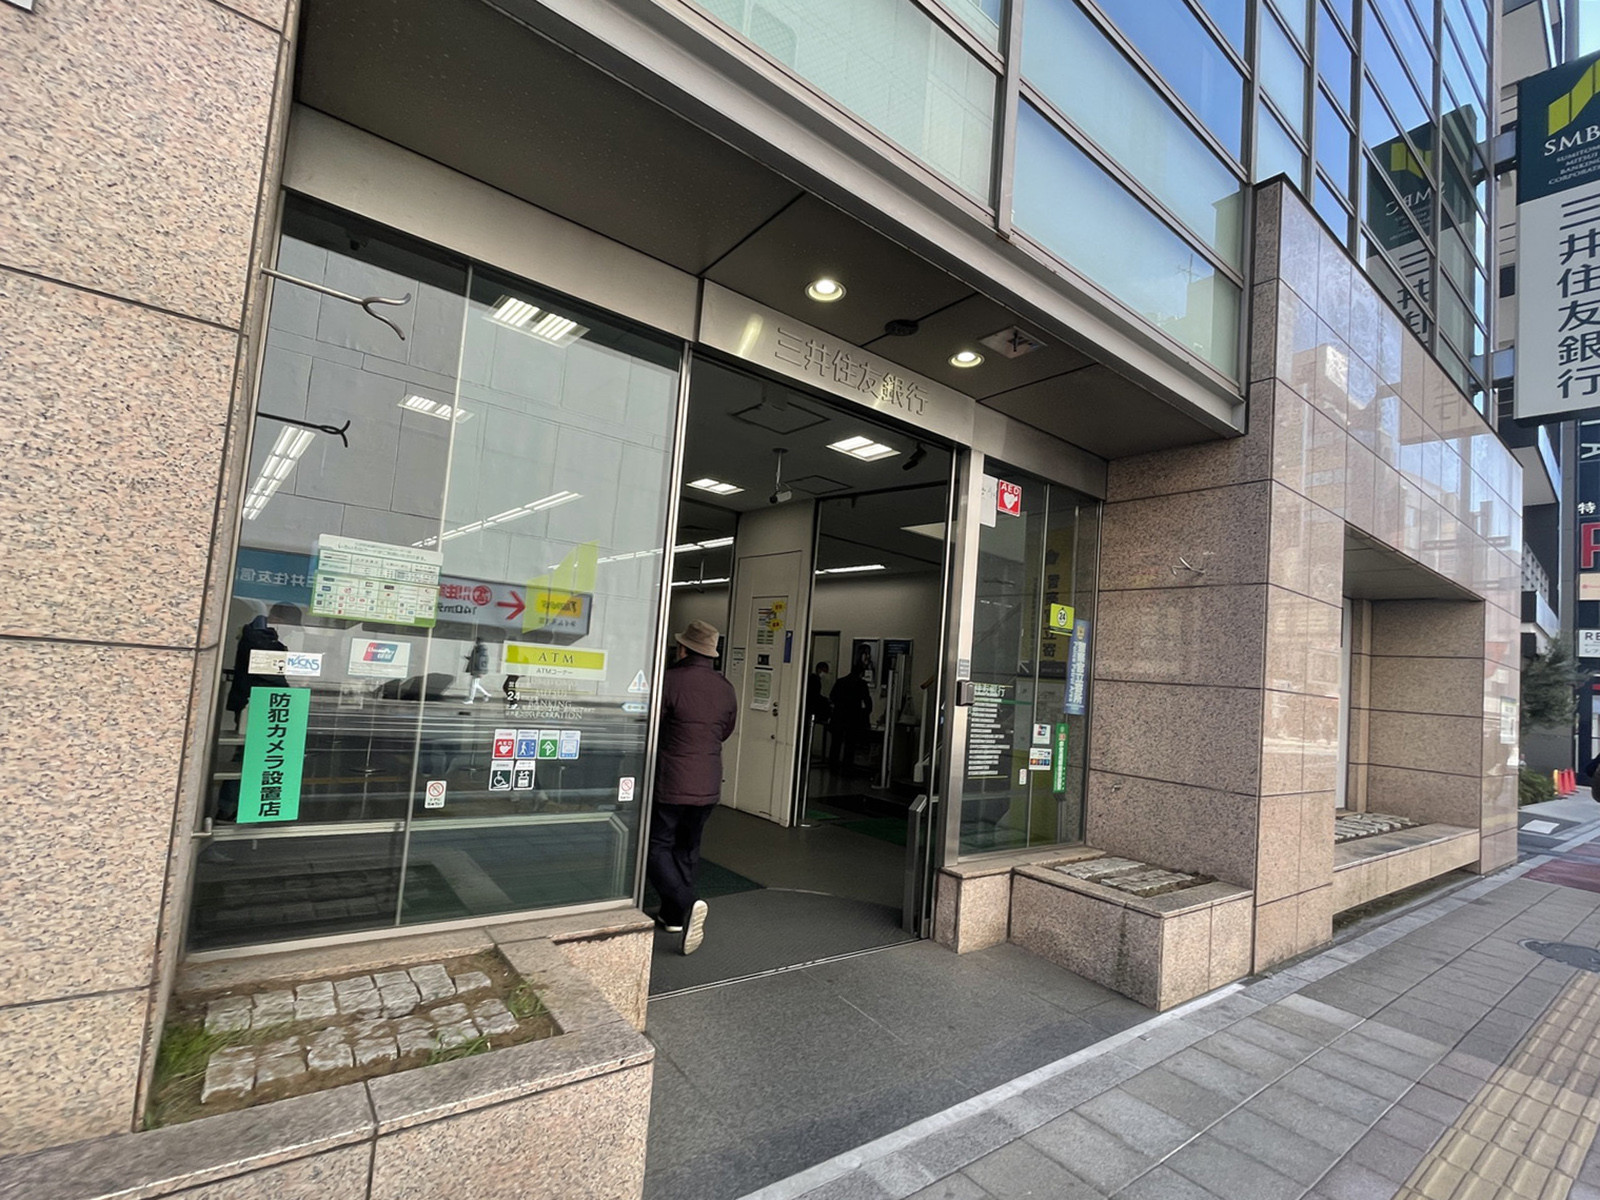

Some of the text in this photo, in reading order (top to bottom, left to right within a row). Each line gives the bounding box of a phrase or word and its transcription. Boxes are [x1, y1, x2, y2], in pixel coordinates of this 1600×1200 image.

[1556, 193, 1600, 399] 三井住友銀行
[775, 327, 929, 417] 三井住友銀行
[1001, 482, 1020, 496] AED
[538, 652, 574, 664] ATM
[536, 668, 574, 676] ATMコーナー
[507, 691, 521, 701] 24
[258, 692, 292, 817] 防犯カメラ設置店
